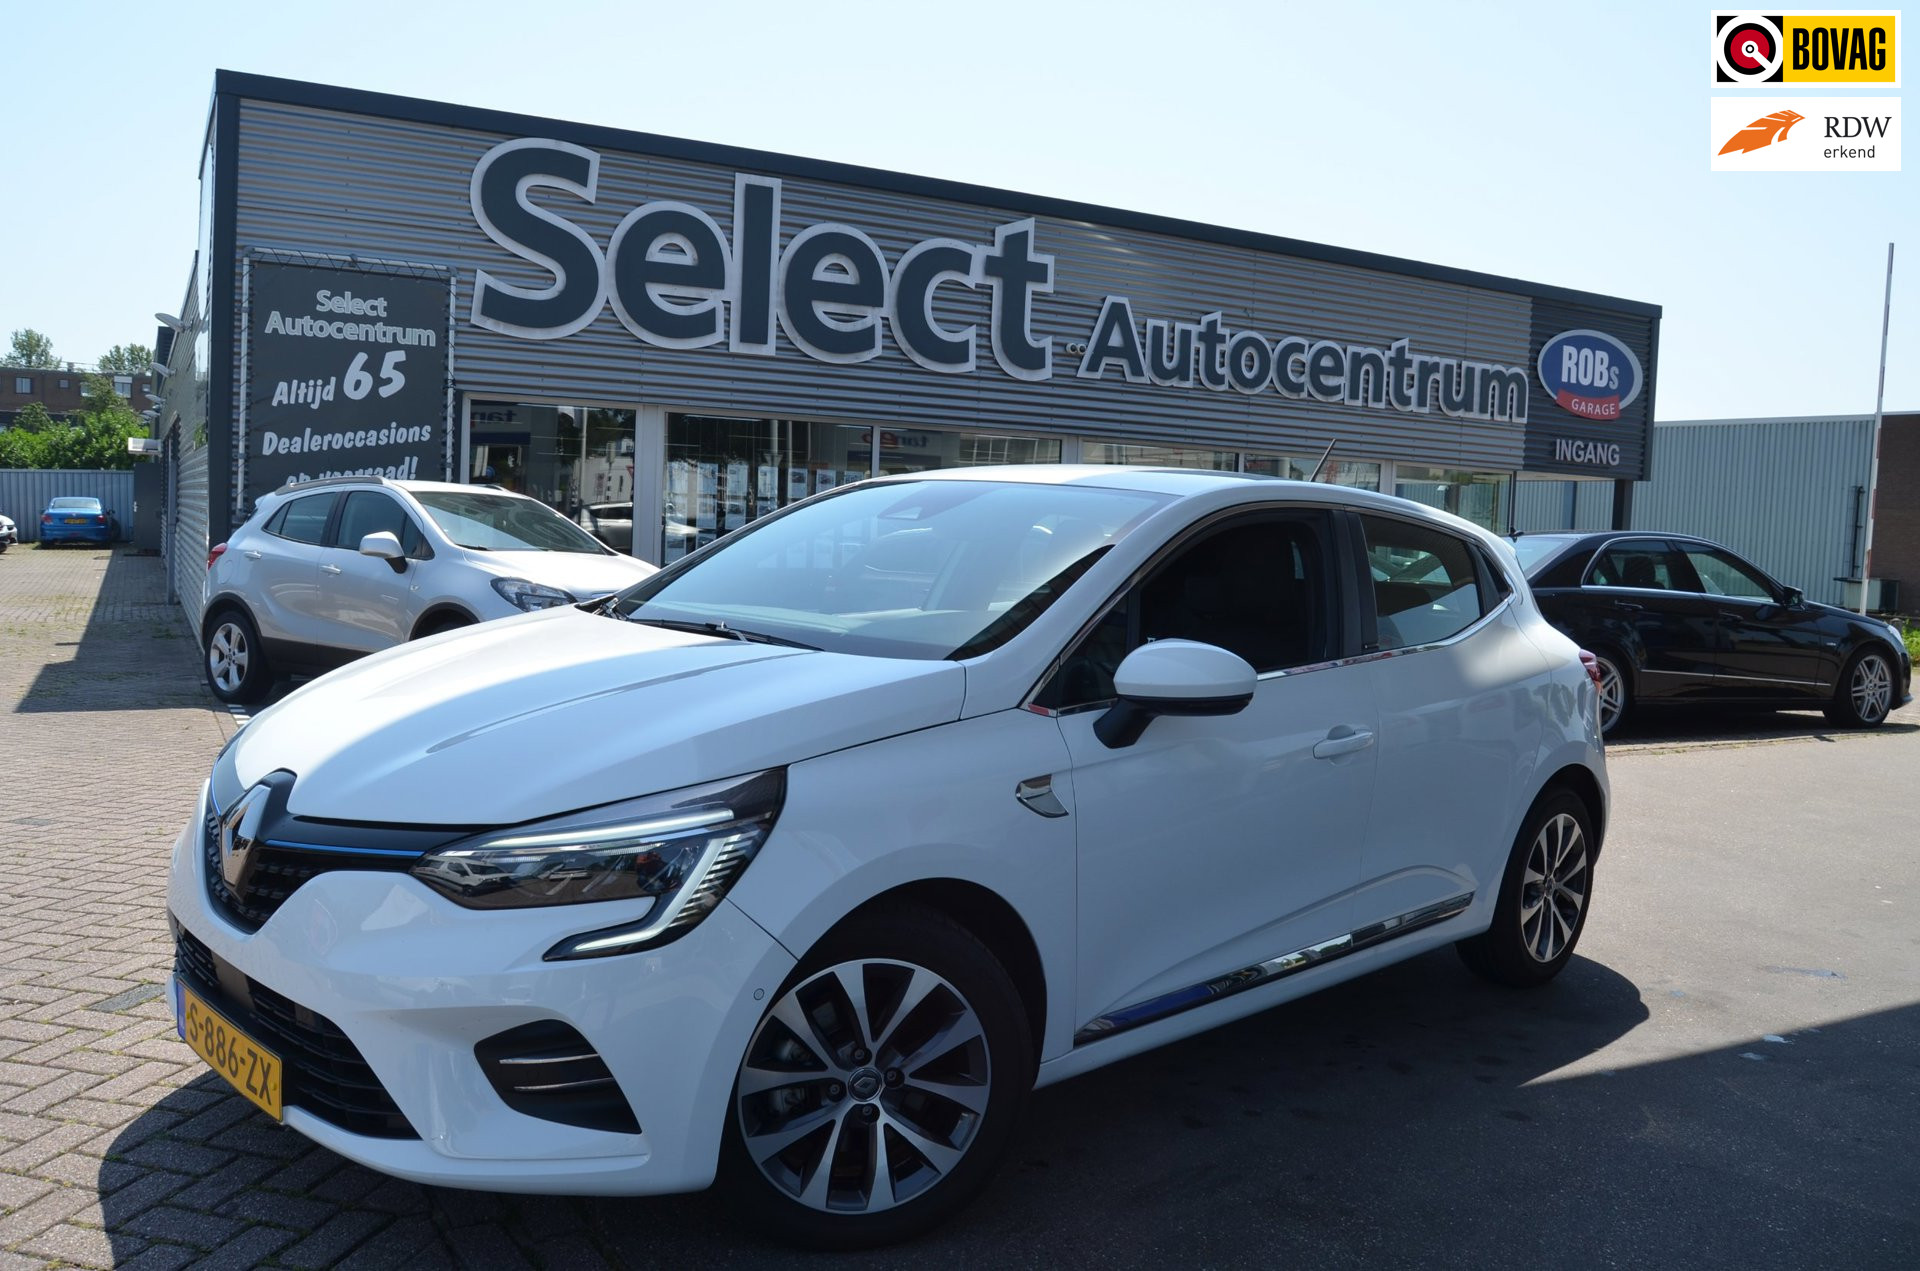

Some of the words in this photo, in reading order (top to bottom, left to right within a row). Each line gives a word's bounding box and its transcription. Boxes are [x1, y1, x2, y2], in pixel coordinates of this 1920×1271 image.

[469, 137, 1054, 381] Select
[1077, 296, 1528, 423] Autocentrum
[316, 289, 388, 318] Select
[264, 310, 436, 347] Autocentrum
[271, 376, 337, 410] Altijd
[343, 350, 406, 400] 65
[1571, 398, 1616, 415] GARAGE
[262, 421, 431, 456] Dealeroccasions
[1555, 438, 1620, 466] INGANG
[189, 1002, 272, 1106] S-886-ZX
